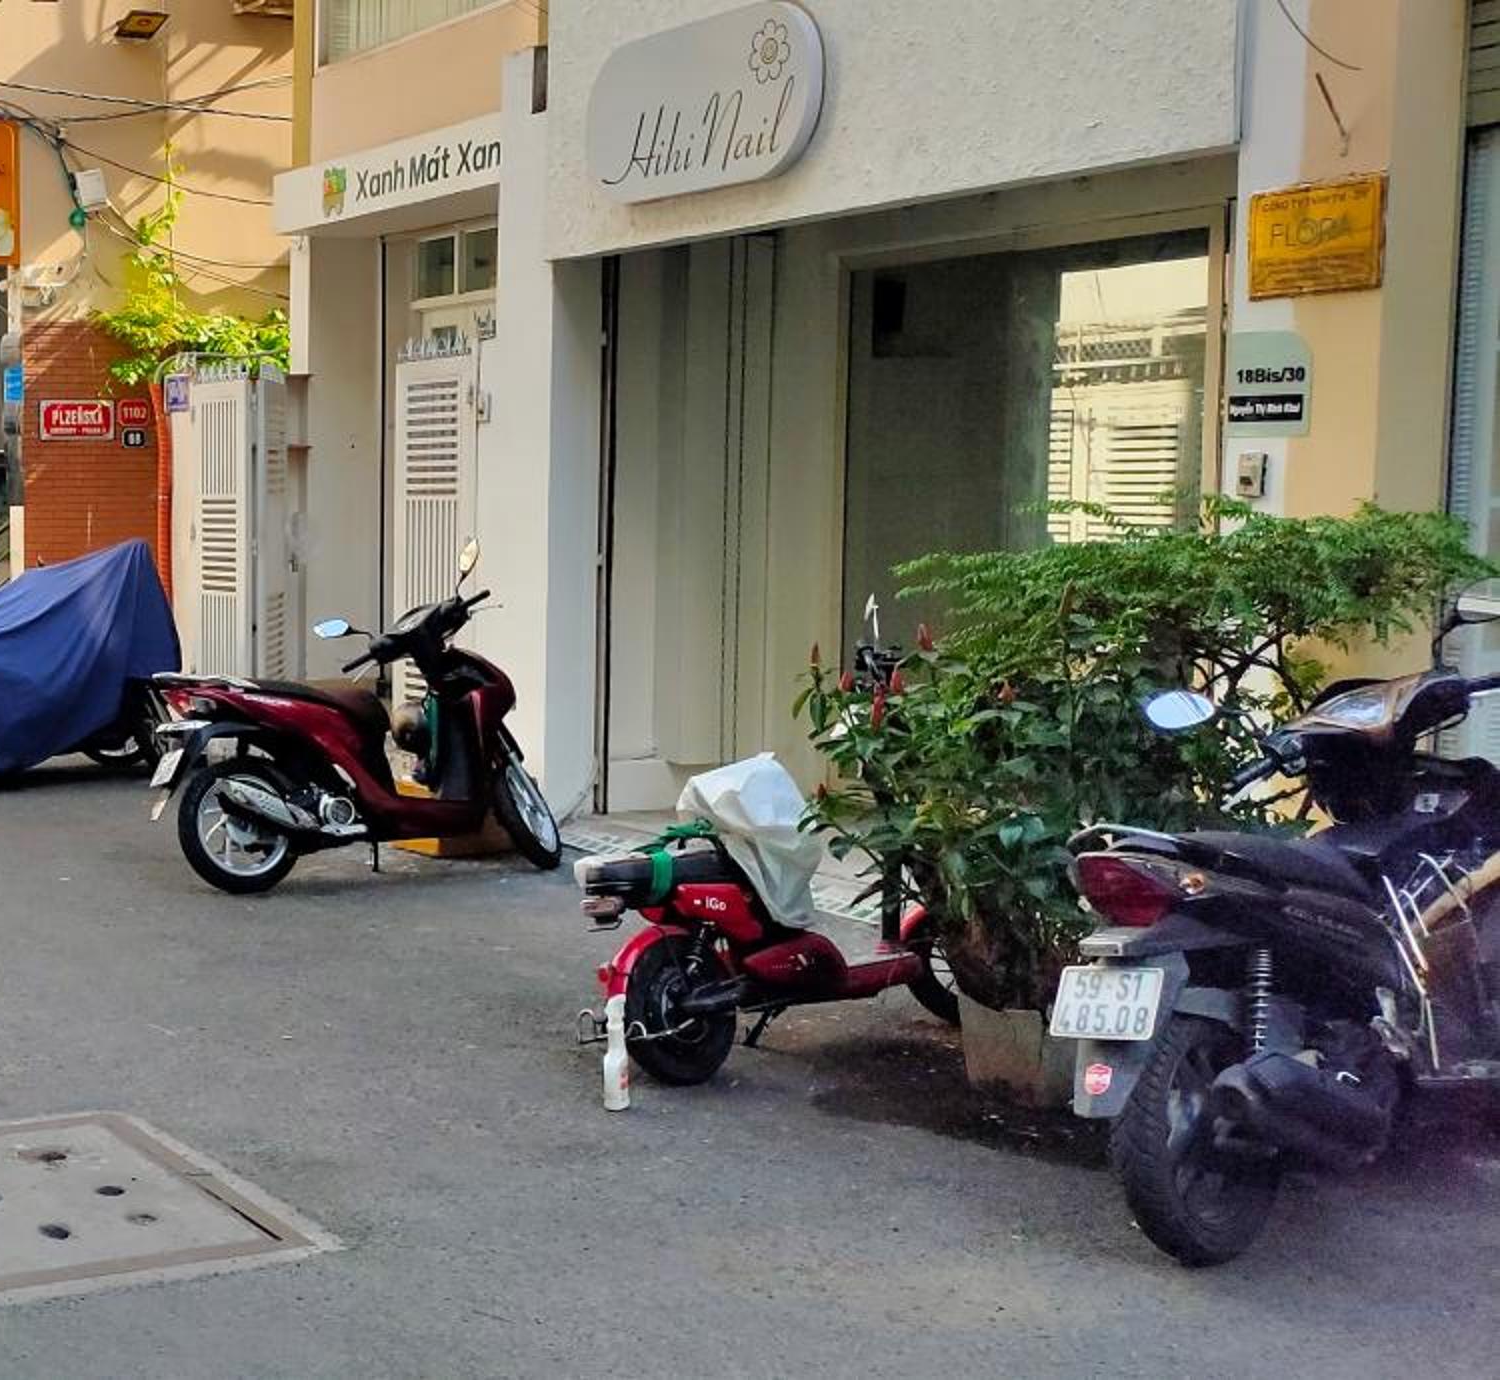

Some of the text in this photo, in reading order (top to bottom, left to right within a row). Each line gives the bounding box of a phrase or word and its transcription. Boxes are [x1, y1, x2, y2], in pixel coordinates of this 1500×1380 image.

[601, 75, 794, 185] Hihi Nail
[355, 160, 405, 201] Xanh
[409, 145, 450, 188] Mát
[1236, 366, 1305, 383] 18Bis/30
[123, 406, 147, 418] 1102
[1059, 1004, 1149, 1035] 485.08
